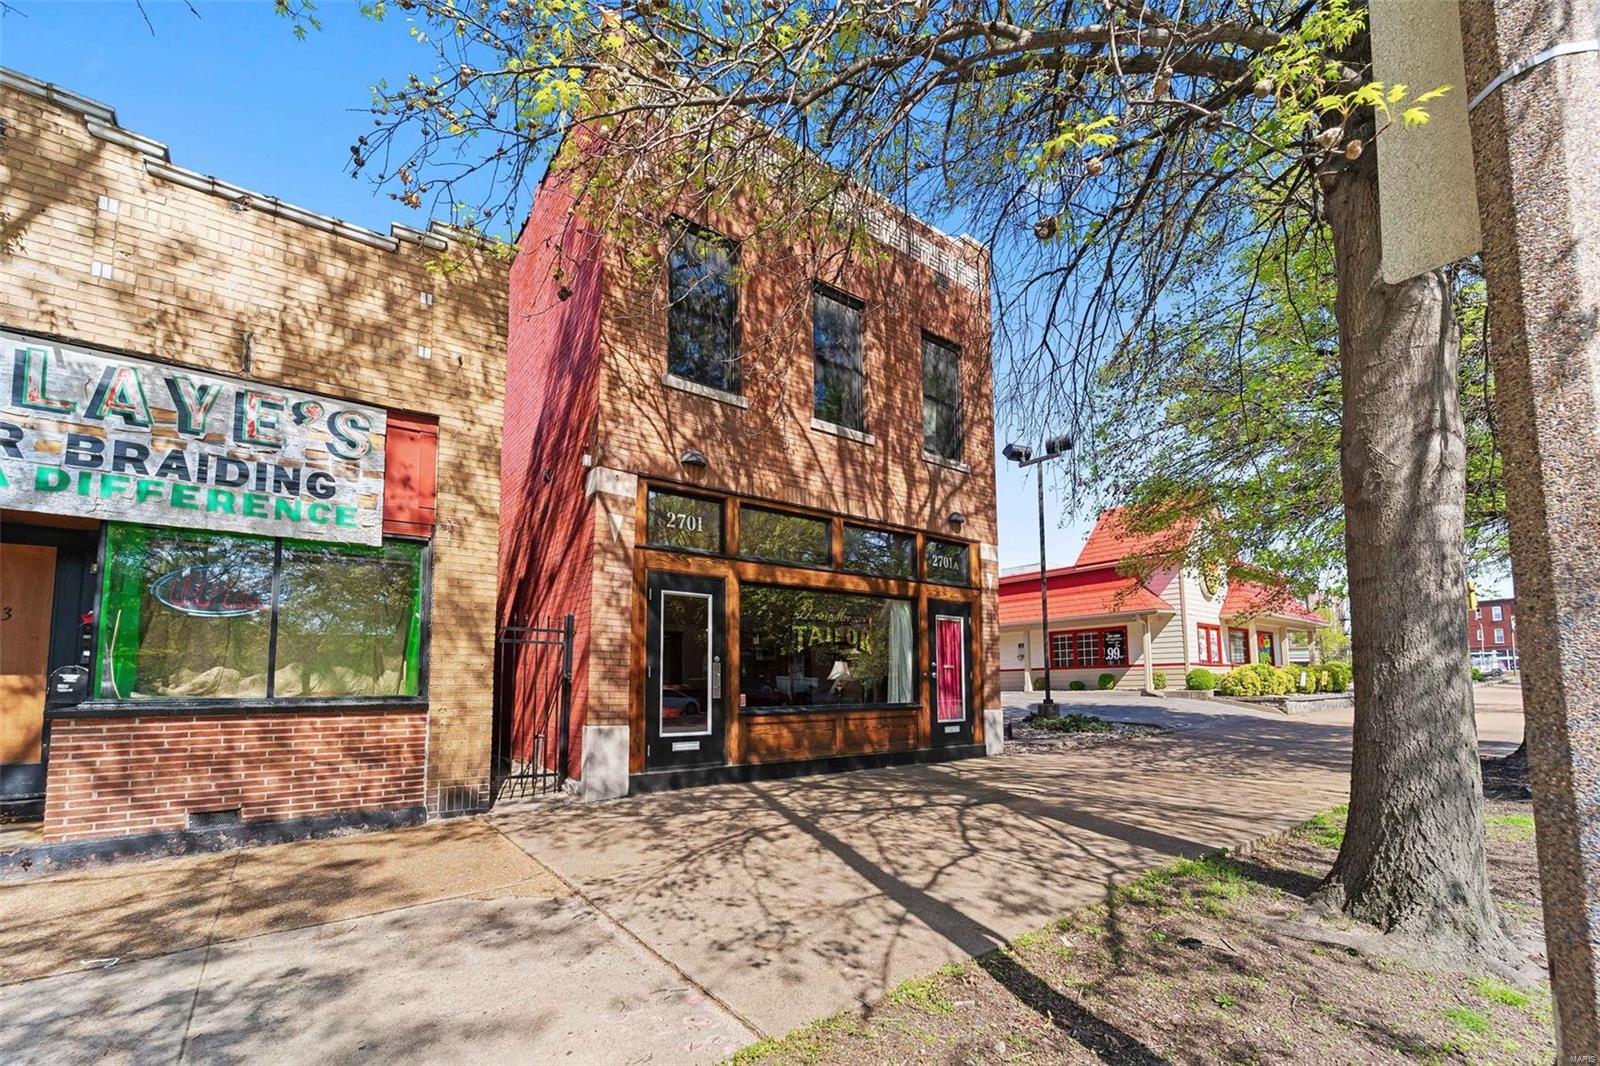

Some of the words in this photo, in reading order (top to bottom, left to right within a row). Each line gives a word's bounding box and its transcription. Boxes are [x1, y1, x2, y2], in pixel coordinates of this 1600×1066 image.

[12, 346, 372, 460] LAYE'S
[35, 466, 359, 529] DIFFERENCE
[65, 433, 337, 500] BRAIDING
[666, 511, 703, 532] 2701
[1, 606, 13, 621] 3
